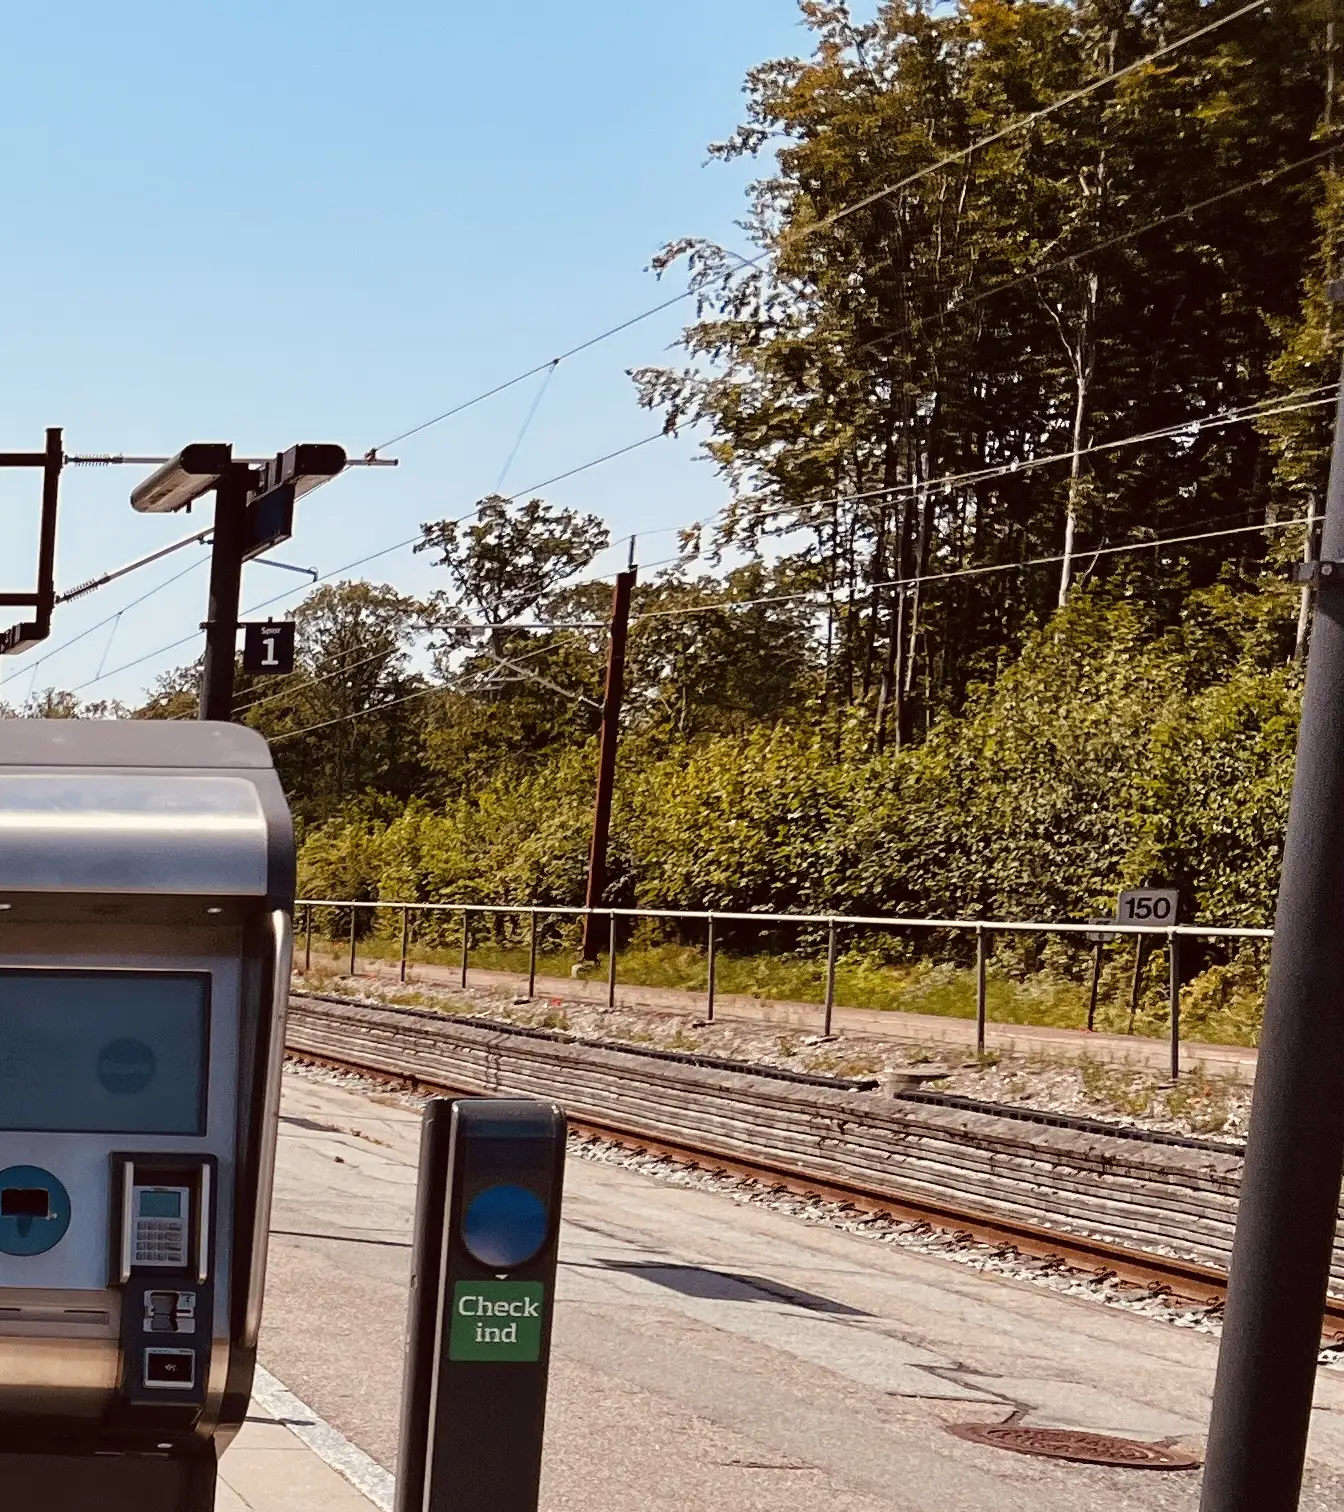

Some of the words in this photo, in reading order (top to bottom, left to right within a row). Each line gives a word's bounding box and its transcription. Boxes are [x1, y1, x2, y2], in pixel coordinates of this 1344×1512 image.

[262, 638, 279, 665] 1
[1125, 898, 1170, 919] 150
[458, 1296, 538, 1317] Check
[475, 1323, 517, 1342] ind
